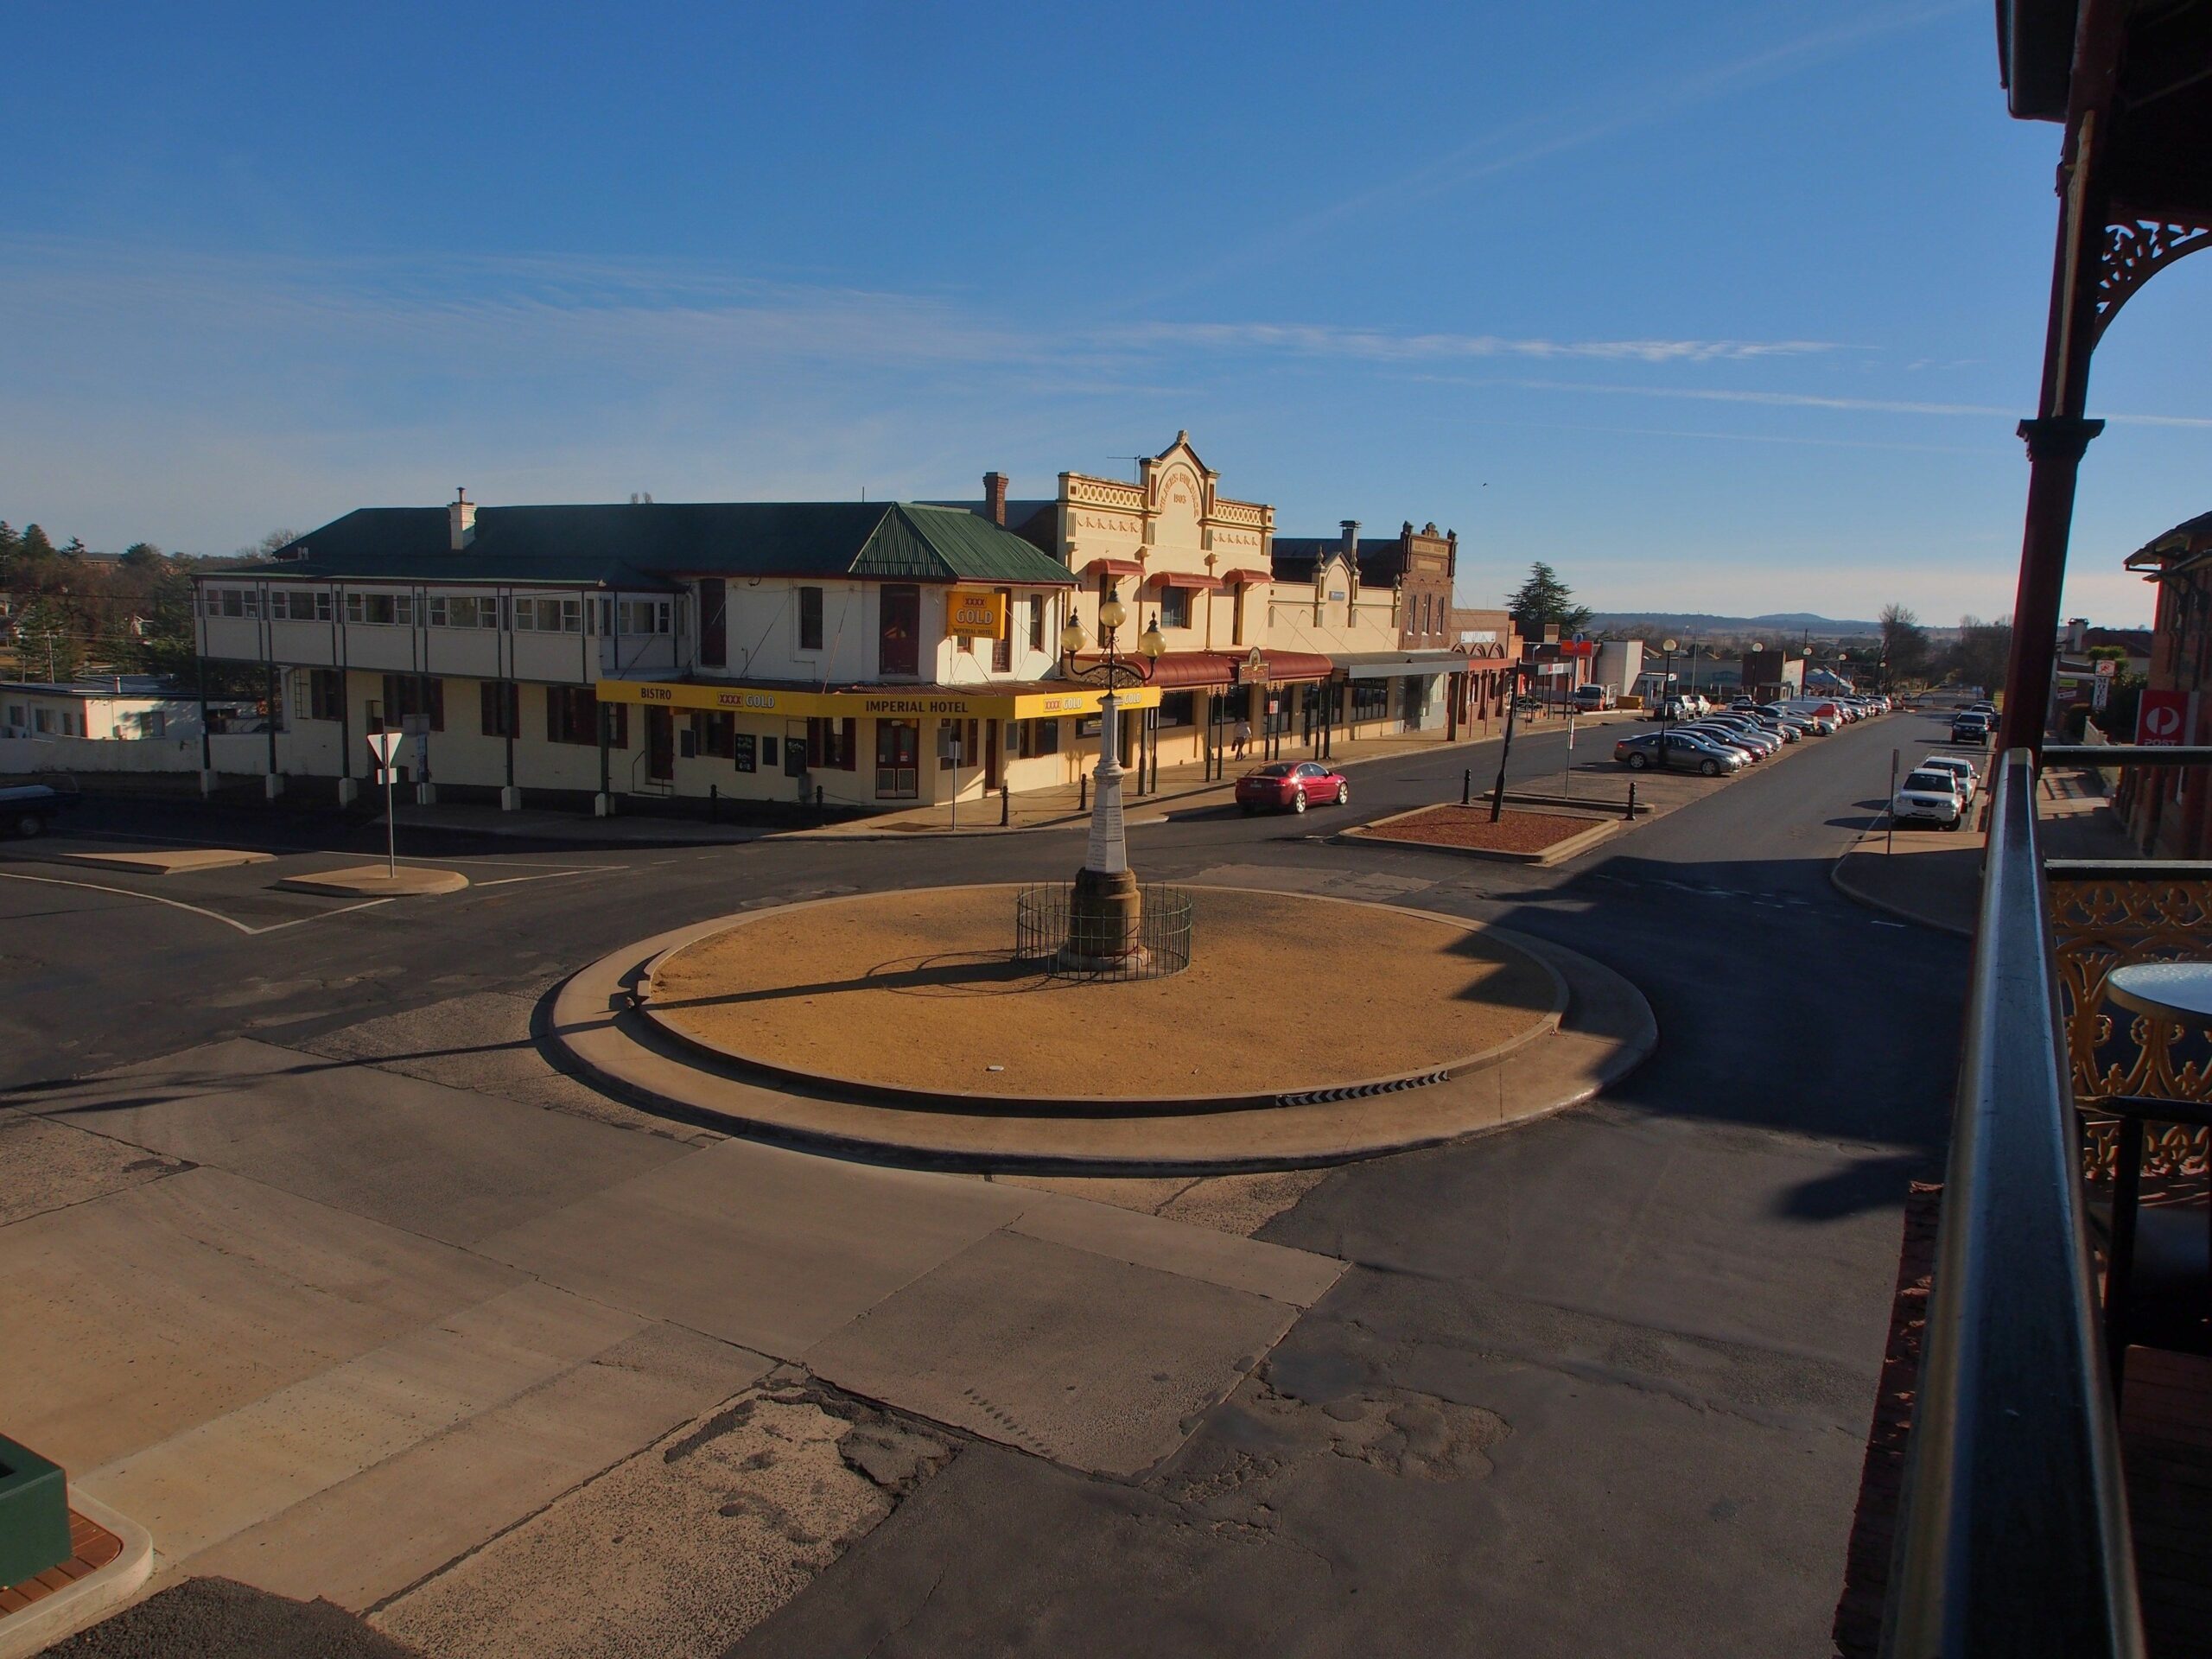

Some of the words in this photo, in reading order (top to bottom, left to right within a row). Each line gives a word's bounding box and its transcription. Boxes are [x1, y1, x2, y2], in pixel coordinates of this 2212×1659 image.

[956, 608, 994, 625] GOLD
[640, 687, 671, 700] BISTRO
[1124, 693, 1141, 704] GOLD
[719, 693, 742, 704] XXXX
[746, 694, 775, 708] GOLD
[1045, 701, 1061, 709] XXXX
[1063, 697, 1083, 709] GOLD
[866, 701, 925, 712] IMPERIAL
[930, 702, 969, 713] HOTEL
